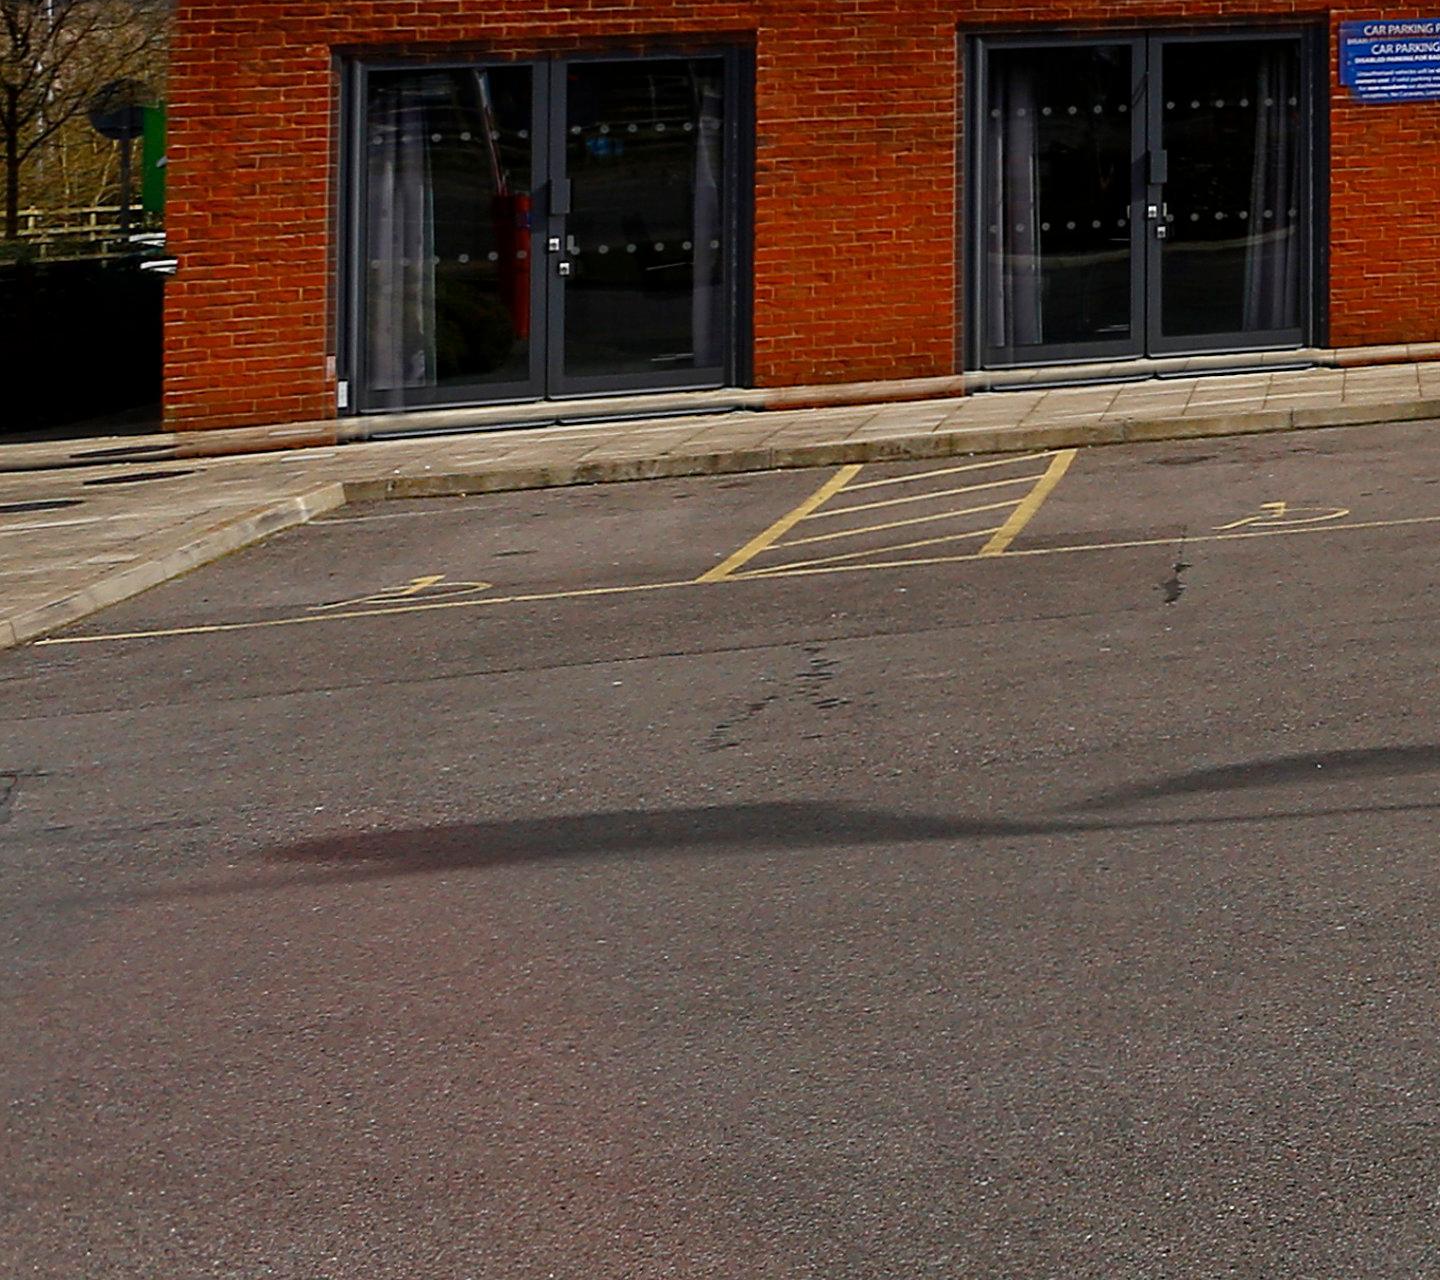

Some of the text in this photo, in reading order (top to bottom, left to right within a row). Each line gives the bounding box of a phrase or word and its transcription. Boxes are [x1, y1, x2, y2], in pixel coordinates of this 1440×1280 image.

[1363, 24, 1387, 36] CAR
[1388, 22, 1434, 35] PARKING
[1371, 43, 1394, 55] CAR
[1395, 41, 1440, 53] PARKING
